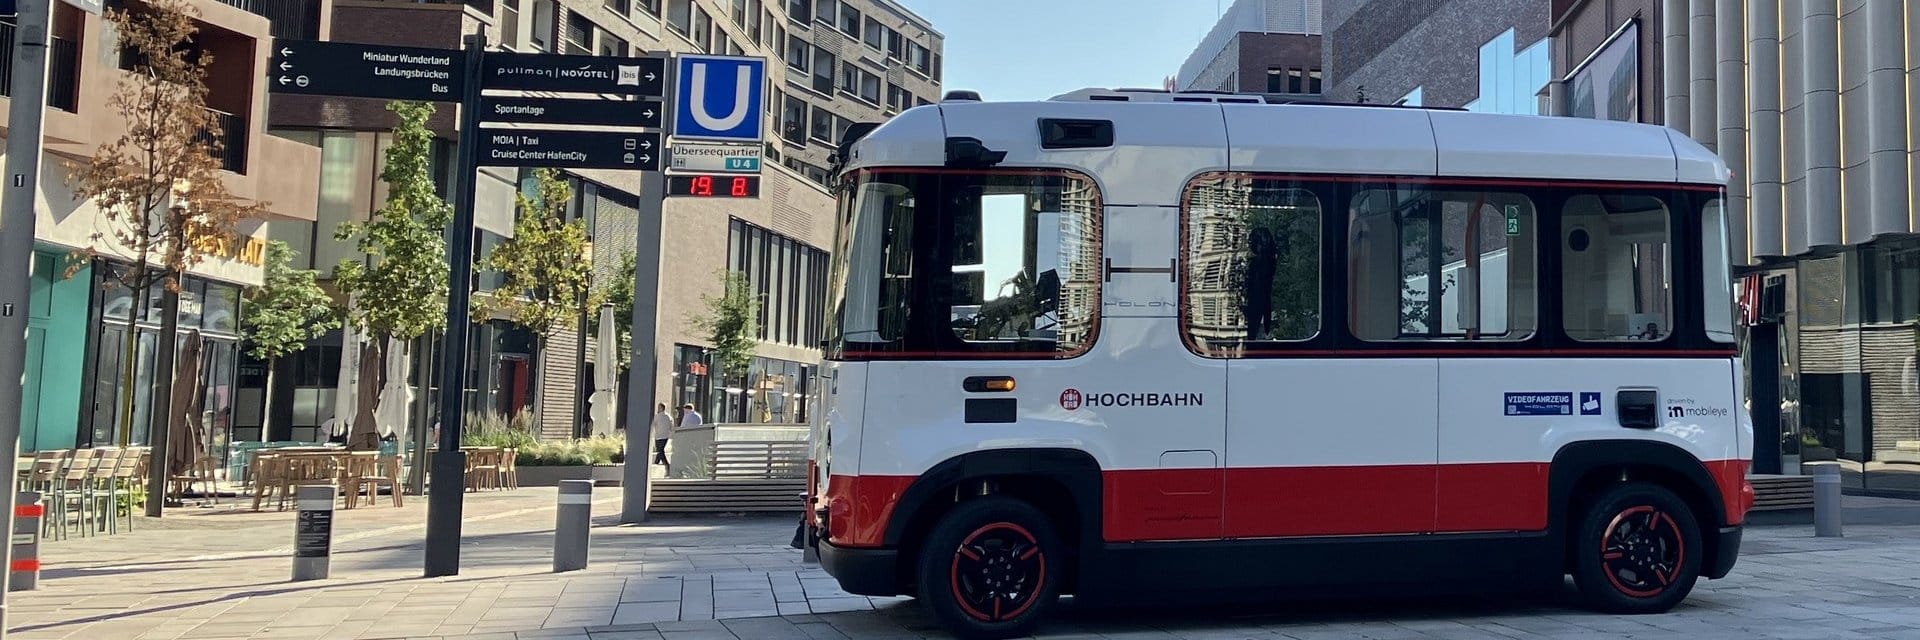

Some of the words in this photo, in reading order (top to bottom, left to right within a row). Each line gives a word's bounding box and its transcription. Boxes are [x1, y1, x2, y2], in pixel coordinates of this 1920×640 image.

[363, 51, 398, 62] Miniatur
[399, 54, 450, 65] Wunderland
[374, 66, 449, 79] Landungsbrücken
[497, 67, 551, 77] pullman
[561, 69, 609, 79] NOVOTEL
[621, 70, 636, 79] ibis
[431, 83, 448, 93] Bus
[689, 62, 752, 131] U
[495, 103, 545, 115] Sportanlage
[492, 135, 515, 145] MOIA
[522, 135, 539, 145] Taxi
[491, 149, 518, 159] Cruise
[518, 150, 546, 160] Center
[547, 151, 588, 162] HafenCity
[673, 144, 759, 157] Überseequartier
[1085, 393, 1203, 406] HOCHBAHN
[1507, 395, 1570, 403] VIDEOFAHRZEUG
[1686, 406, 1728, 418] mobileye
